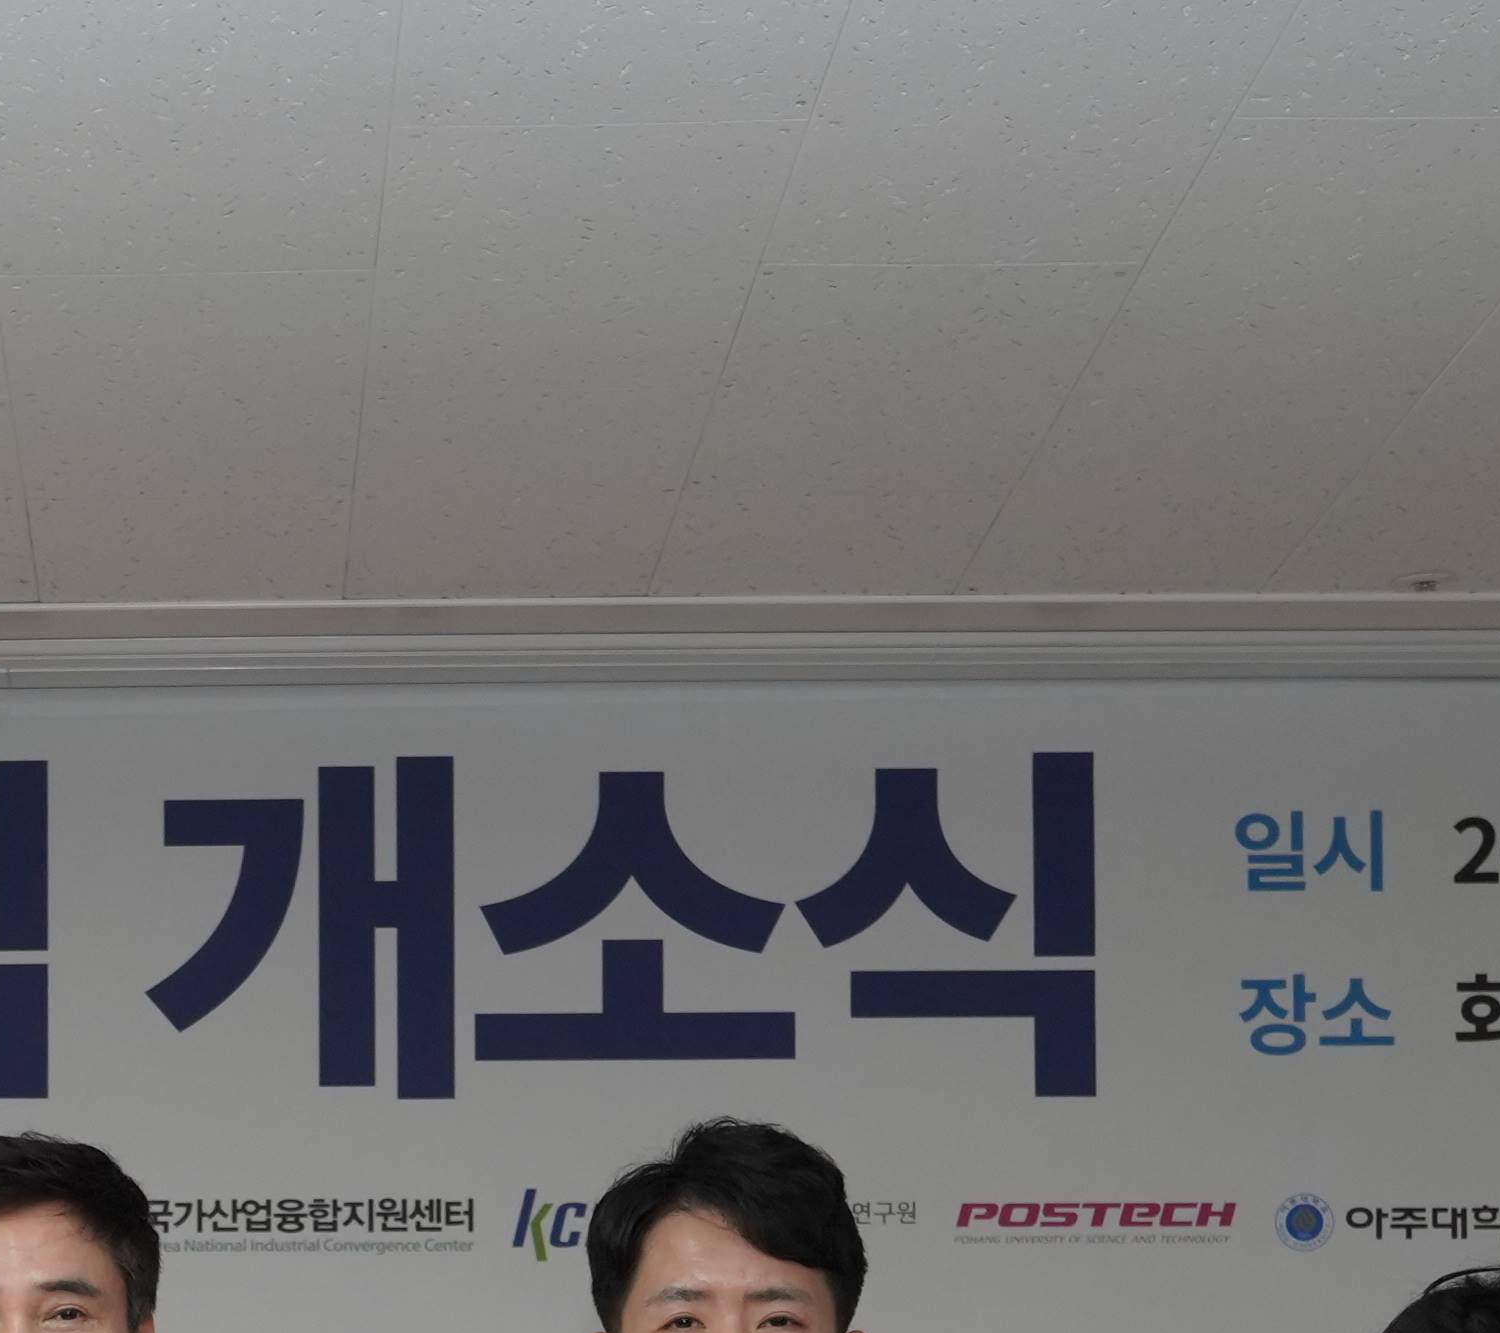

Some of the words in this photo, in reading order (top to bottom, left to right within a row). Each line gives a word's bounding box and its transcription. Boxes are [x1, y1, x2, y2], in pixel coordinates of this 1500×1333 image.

[1234, 810, 1384, 892] 일시
[144, 751, 1097, 1100] 개소식
[1238, 973, 1396, 1056] 장소
[184, 1238, 247, 1253] National
[250, 1238, 320, 1253] Industrial
[323, 1238, 422, 1255] Convergence
[425, 1238, 474, 1253] Center
